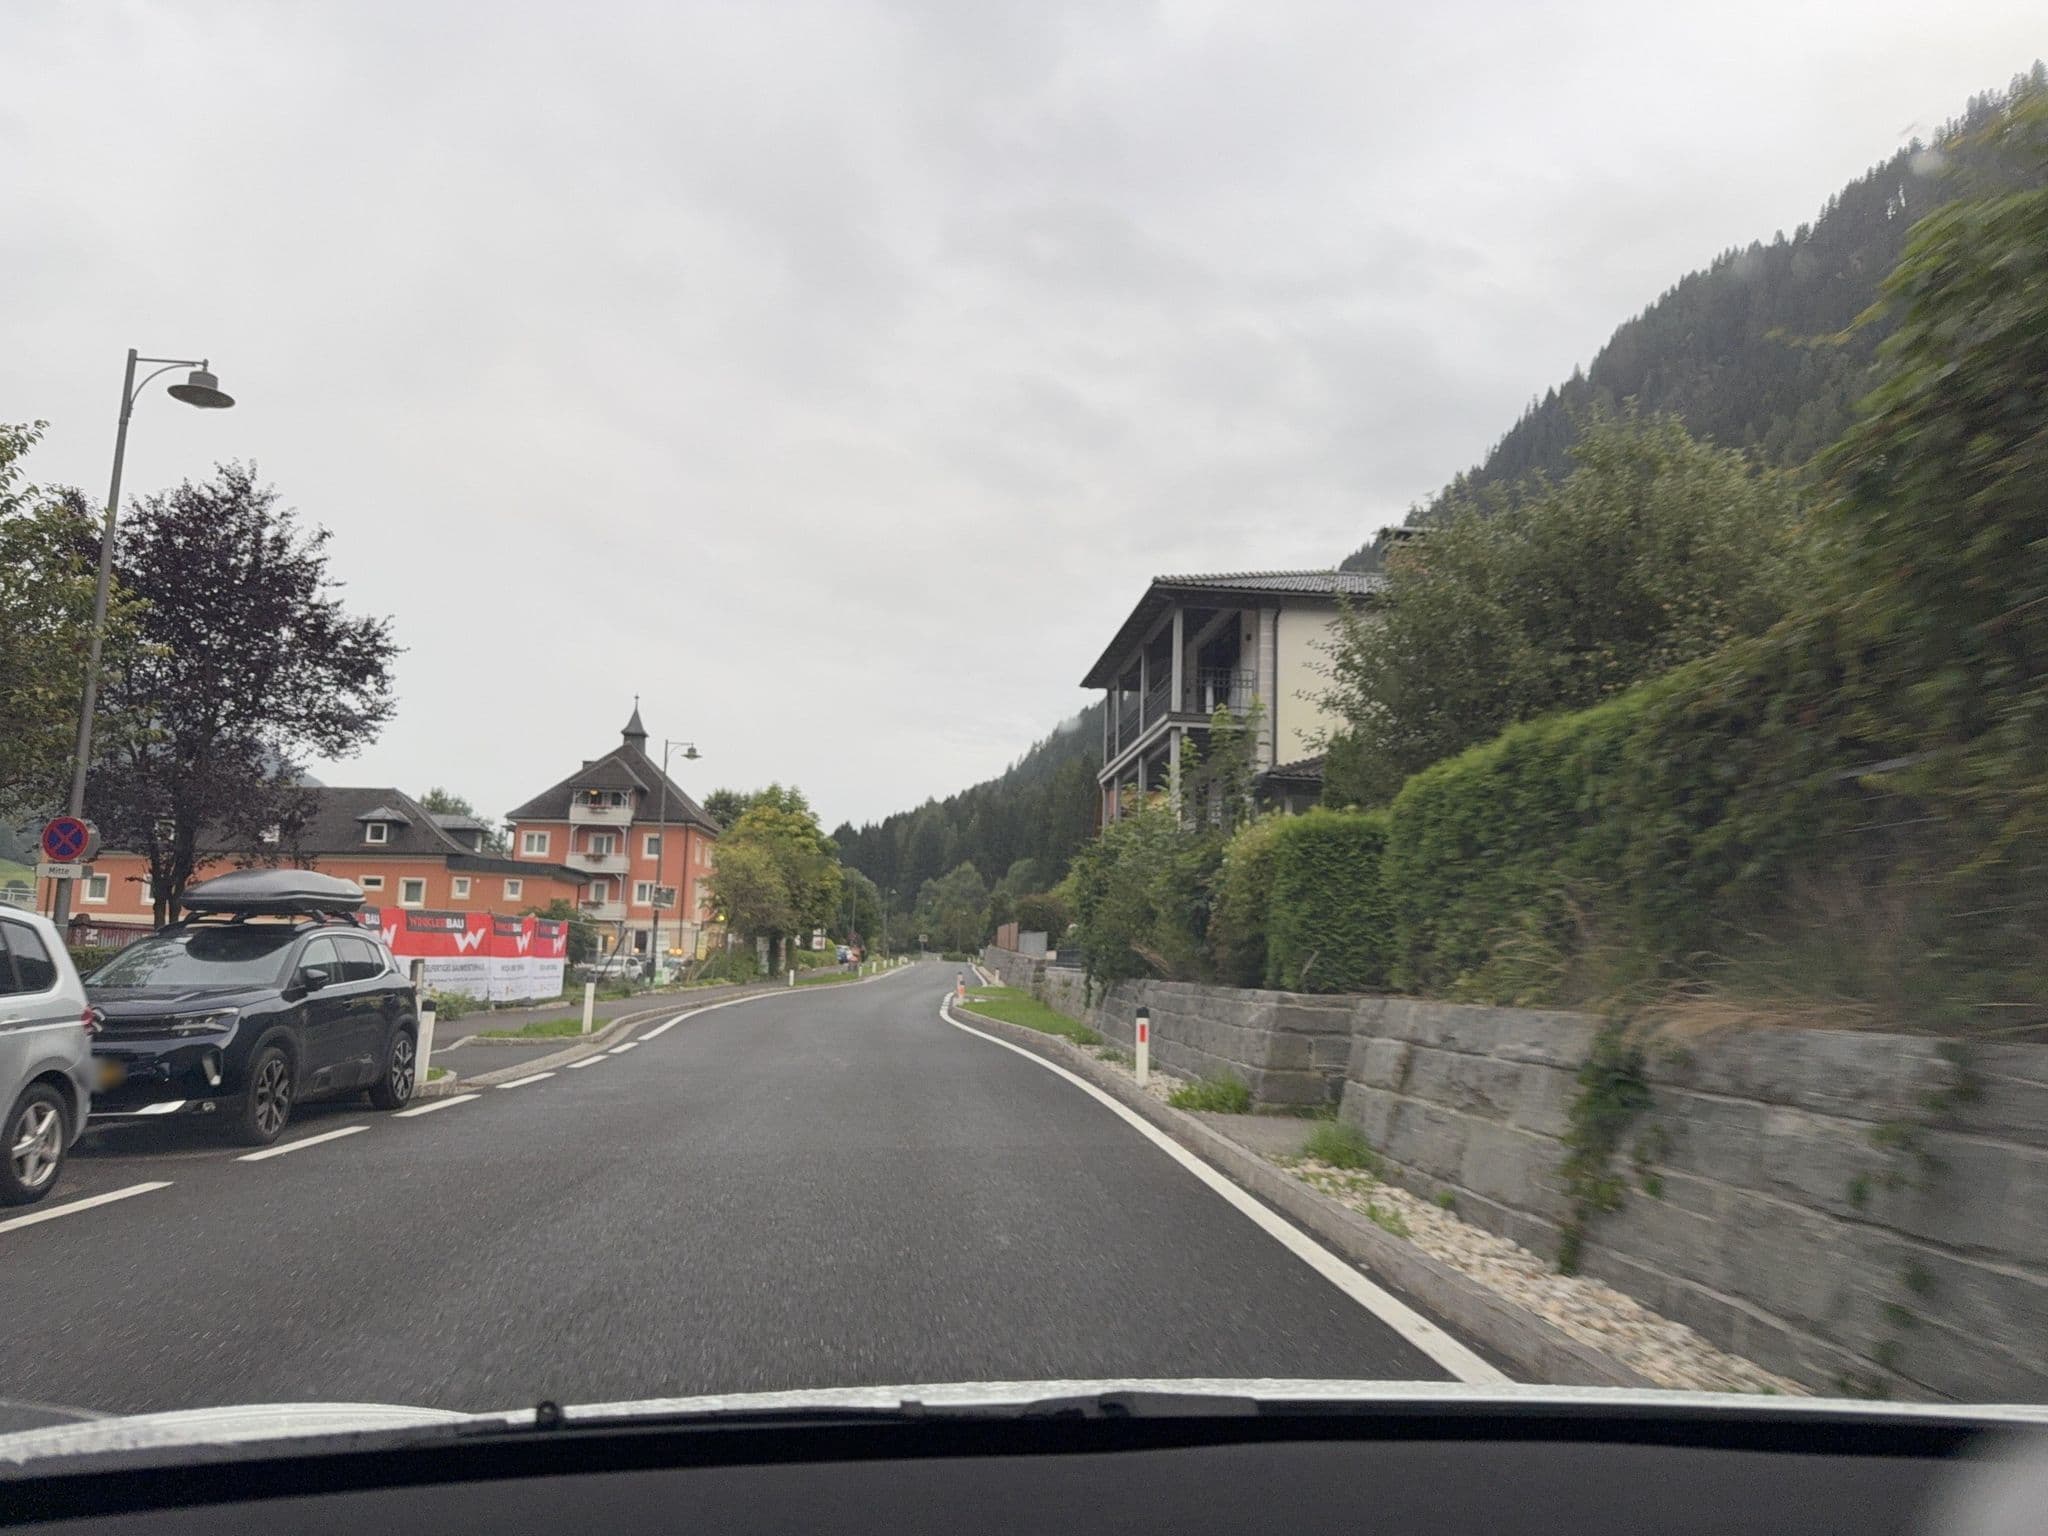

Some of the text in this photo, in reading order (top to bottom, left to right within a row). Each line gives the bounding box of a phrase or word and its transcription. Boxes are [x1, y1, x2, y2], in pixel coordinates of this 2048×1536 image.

[48, 866, 70, 875] Mitte
[453, 928, 486, 953] W
[515, 930, 532, 955] W
